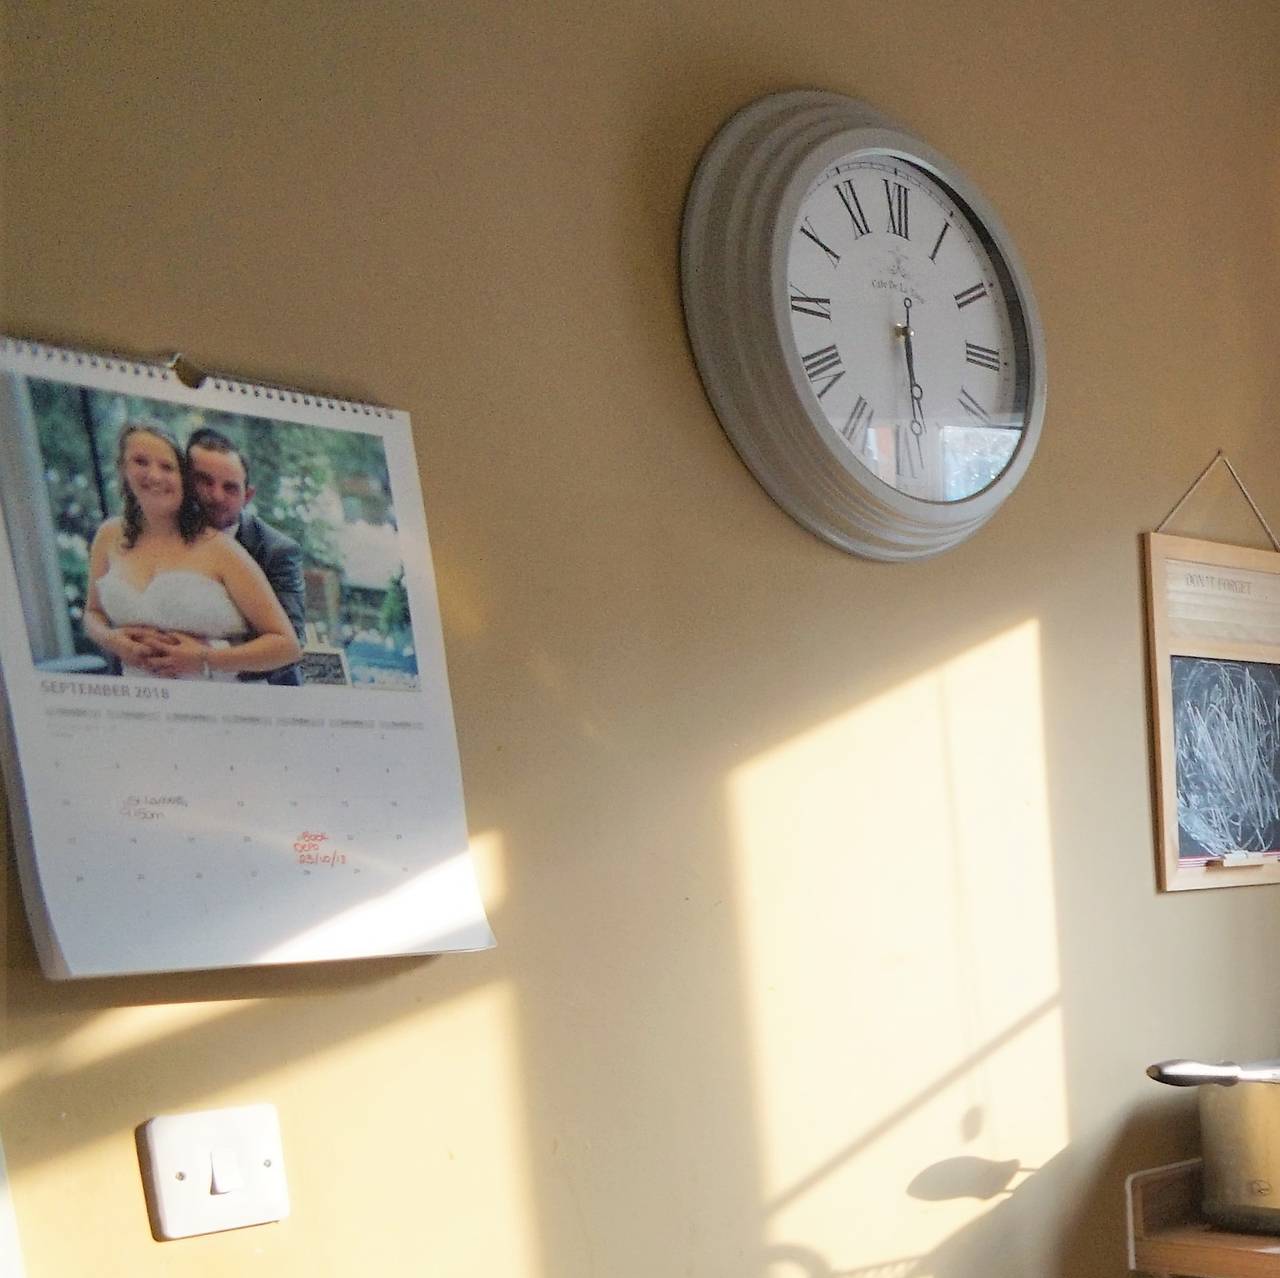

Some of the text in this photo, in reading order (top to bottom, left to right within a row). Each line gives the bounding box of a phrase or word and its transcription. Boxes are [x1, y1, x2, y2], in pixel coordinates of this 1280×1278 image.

[883, 179, 911, 240] XII
[965, 340, 1000, 371] III
[41, 680, 130, 697] SEPTEMBER
